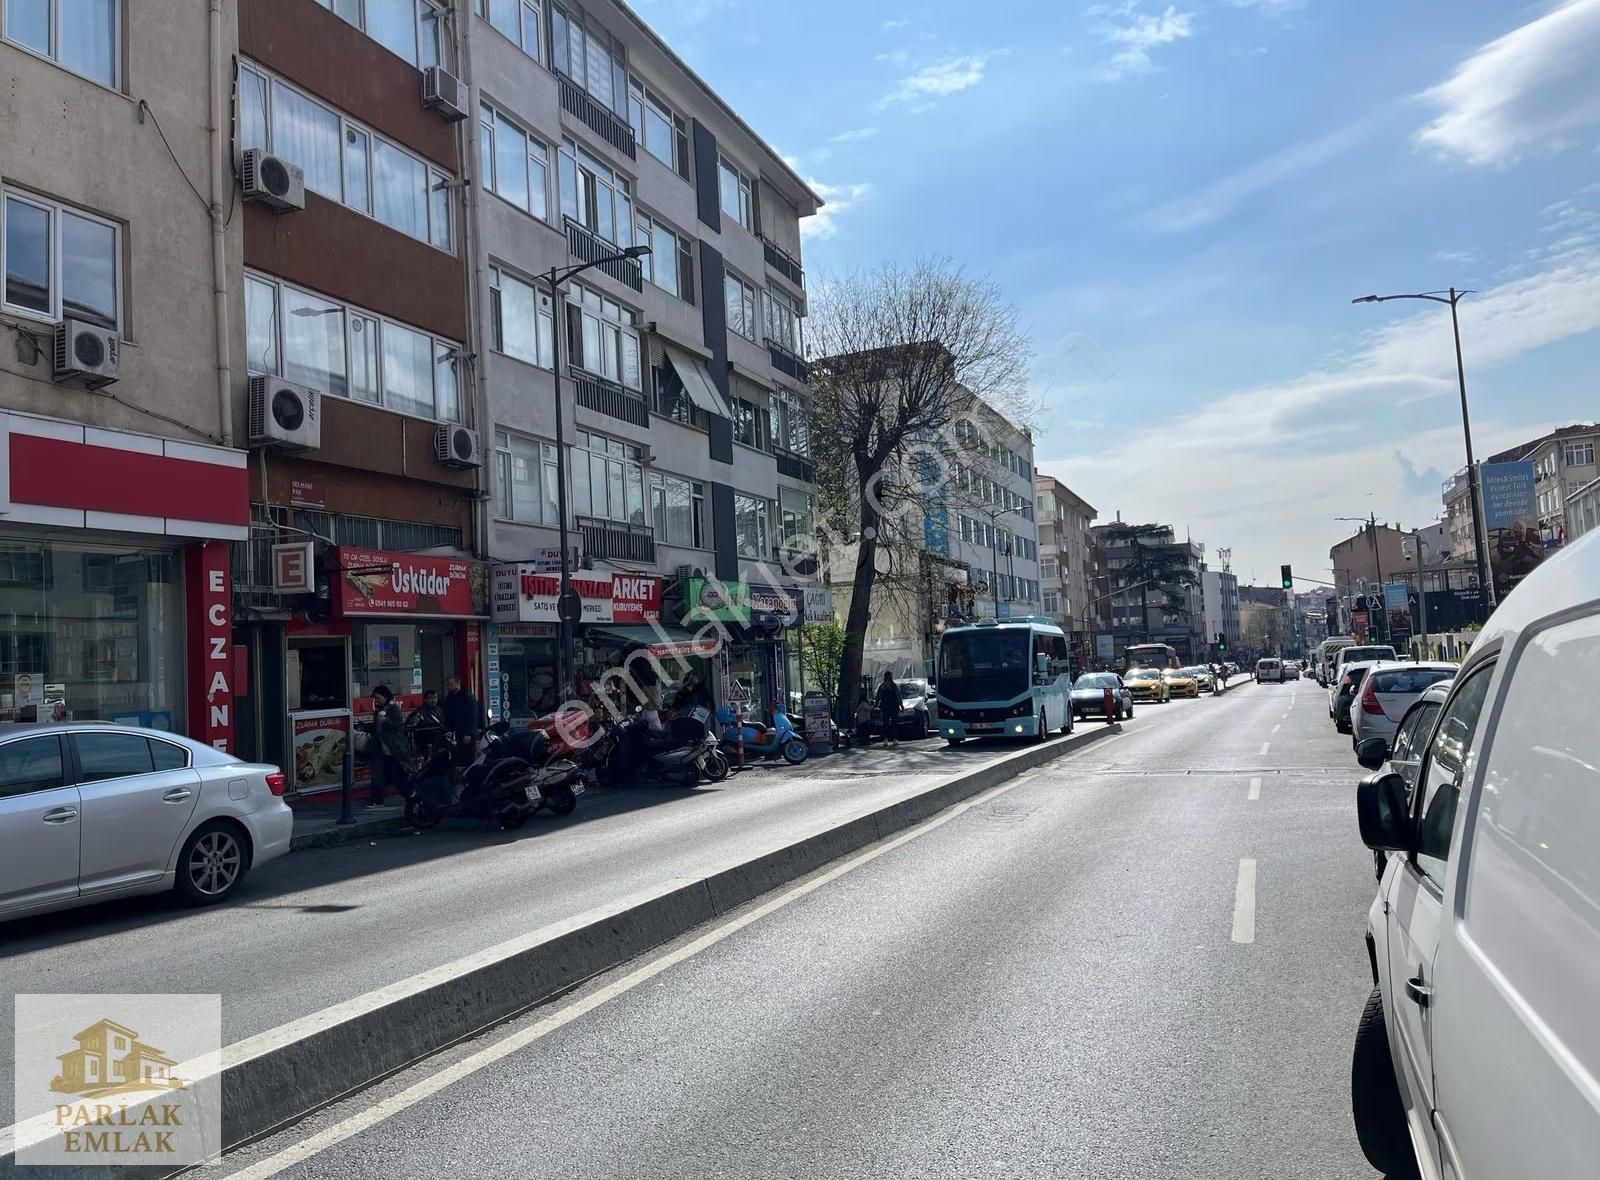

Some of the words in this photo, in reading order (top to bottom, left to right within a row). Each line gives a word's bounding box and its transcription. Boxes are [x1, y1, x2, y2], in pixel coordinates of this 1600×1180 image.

[392, 562, 451, 596] Üsküdar
[496, 569, 518, 577] DUYU
[208, 571, 229, 752] ECZANE
